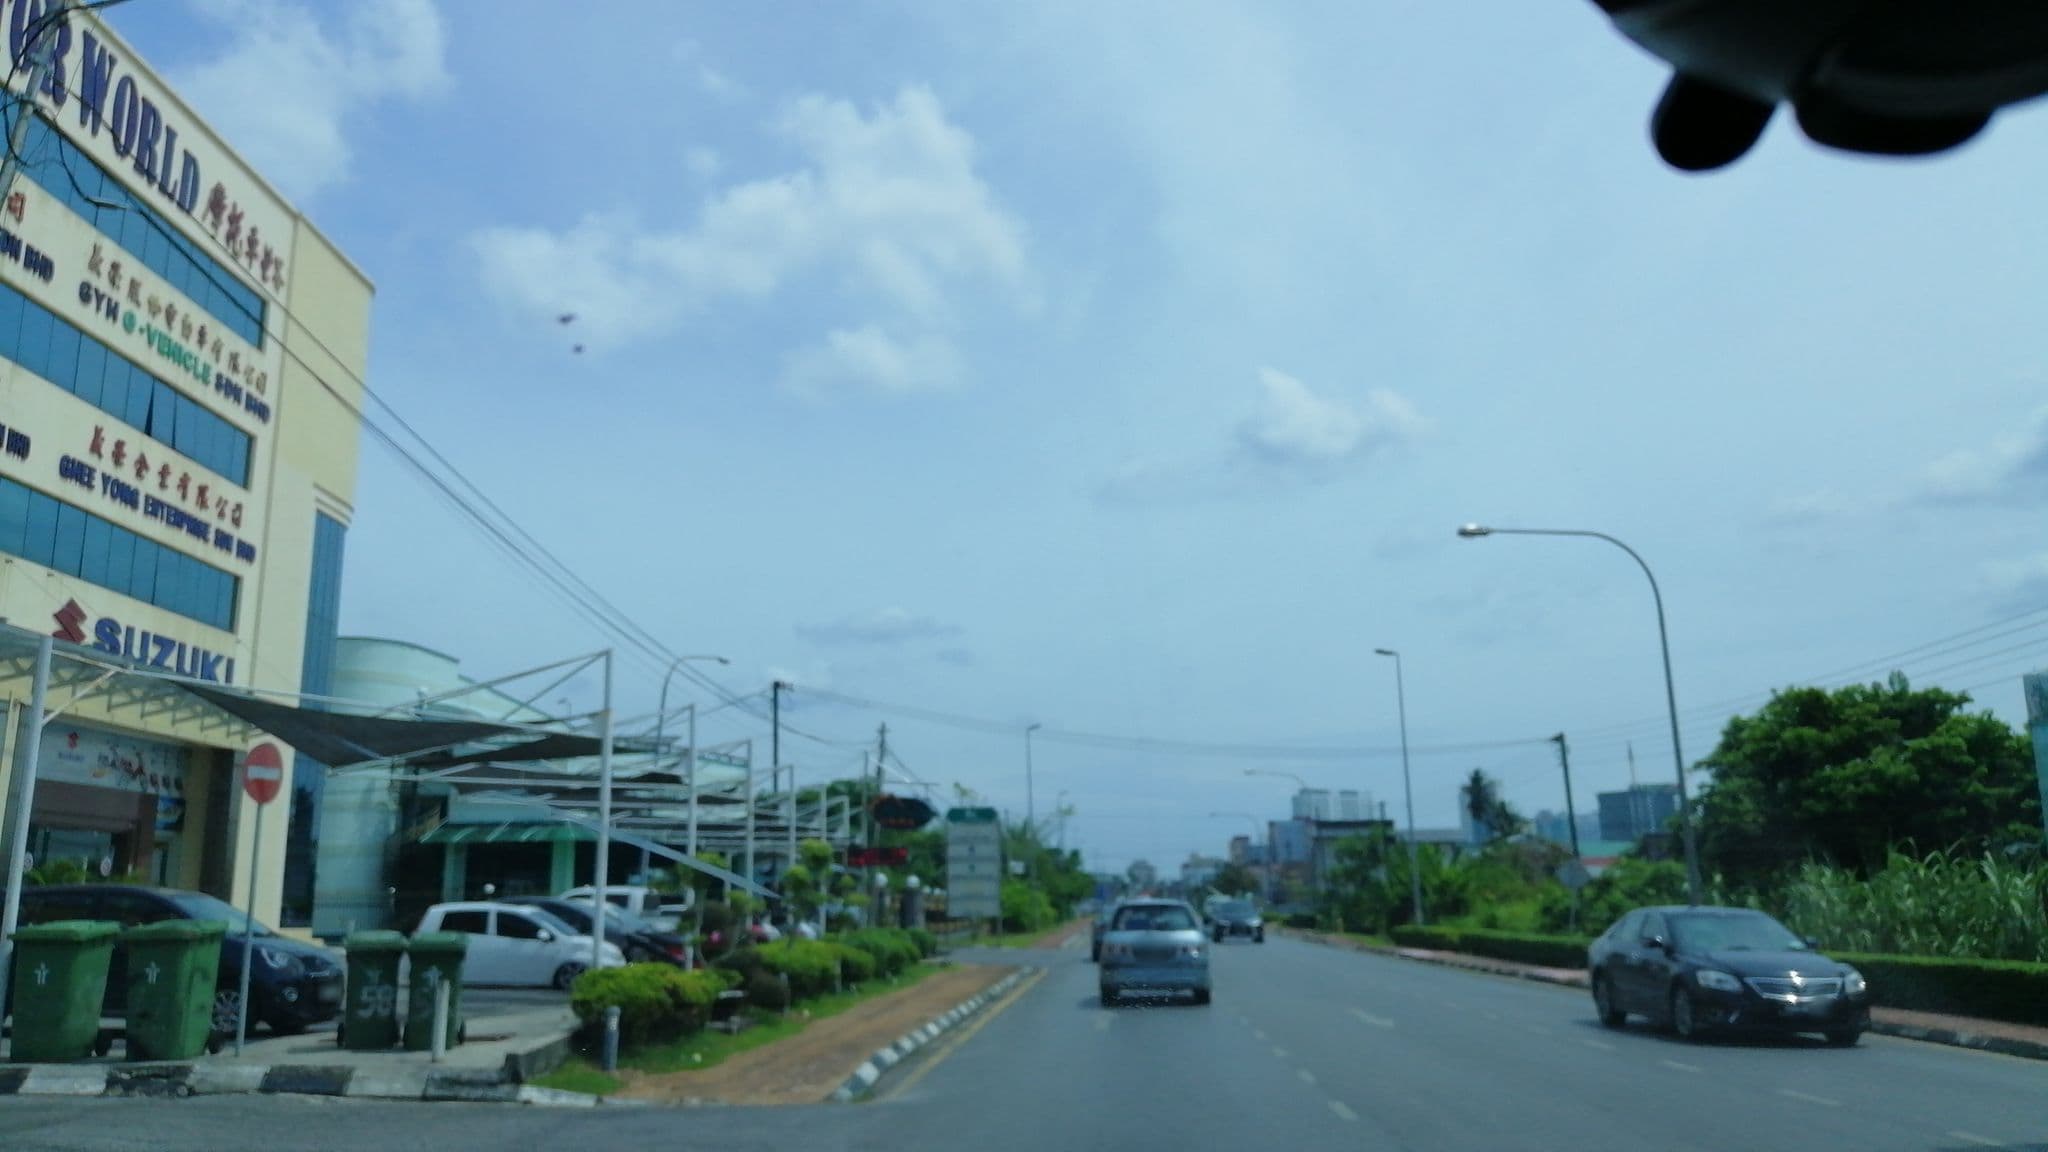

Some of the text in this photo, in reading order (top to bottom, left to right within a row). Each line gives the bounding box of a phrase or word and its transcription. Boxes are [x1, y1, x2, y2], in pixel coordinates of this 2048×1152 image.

[80, 29, 200, 214] WORLD
[215, 372, 242, 404] SDN
[245, 390, 270, 423] BHD
[102, 470, 138, 510] YONG
[144, 494, 211, 543] ENTERPRISE
[94, 617, 235, 684] SUZUKI
